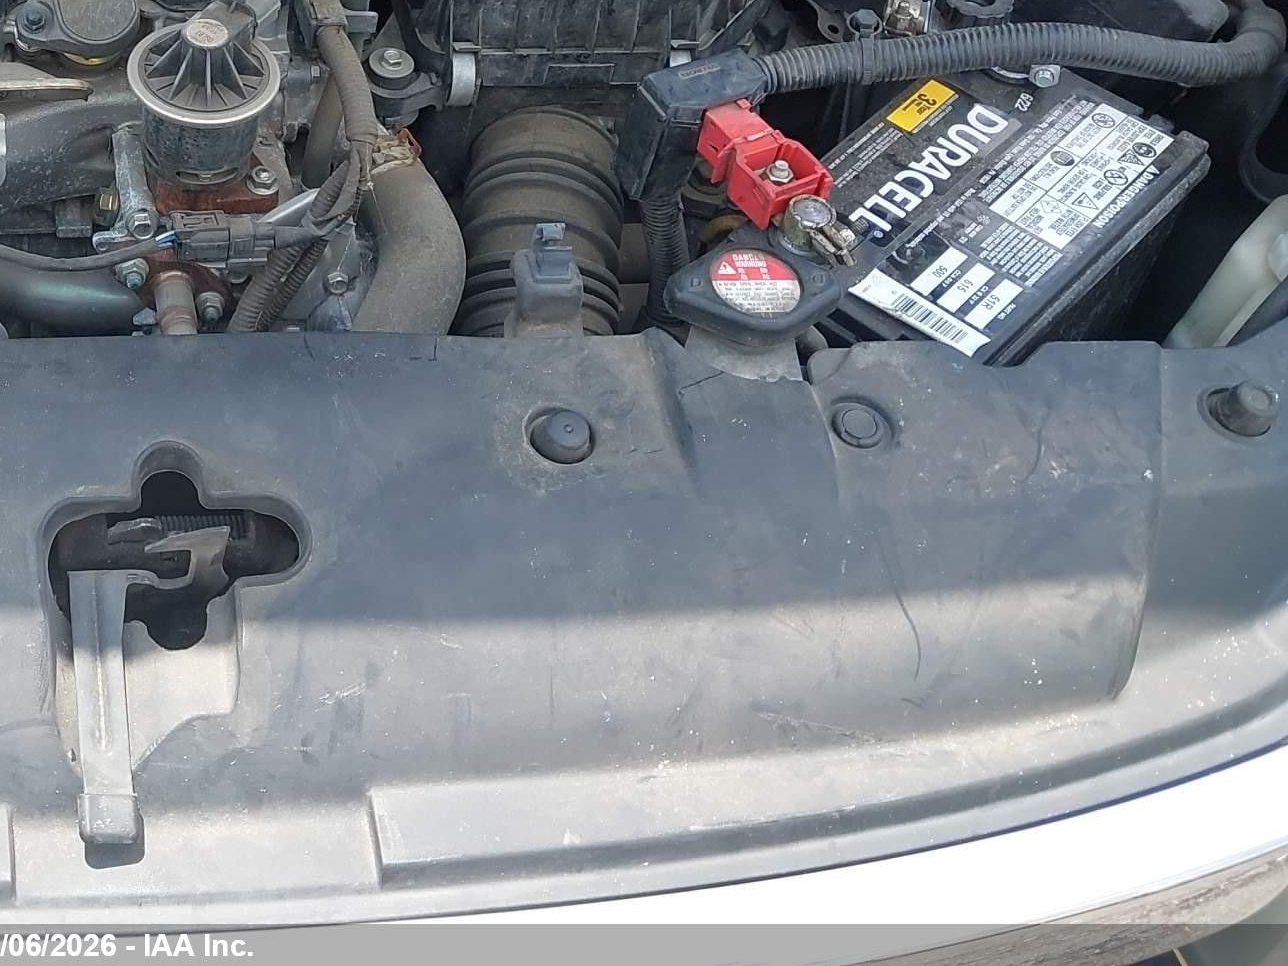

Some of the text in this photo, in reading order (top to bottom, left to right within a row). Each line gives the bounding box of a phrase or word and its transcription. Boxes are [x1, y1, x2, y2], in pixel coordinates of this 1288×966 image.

[918, 93, 937, 106] 3
[1014, 93, 1033, 111] 6/22
[847, 103, 1008, 231] DURACELL
[1091, 171, 1154, 228] DANGER/POISON
[979, 294, 1000, 310] 51R
